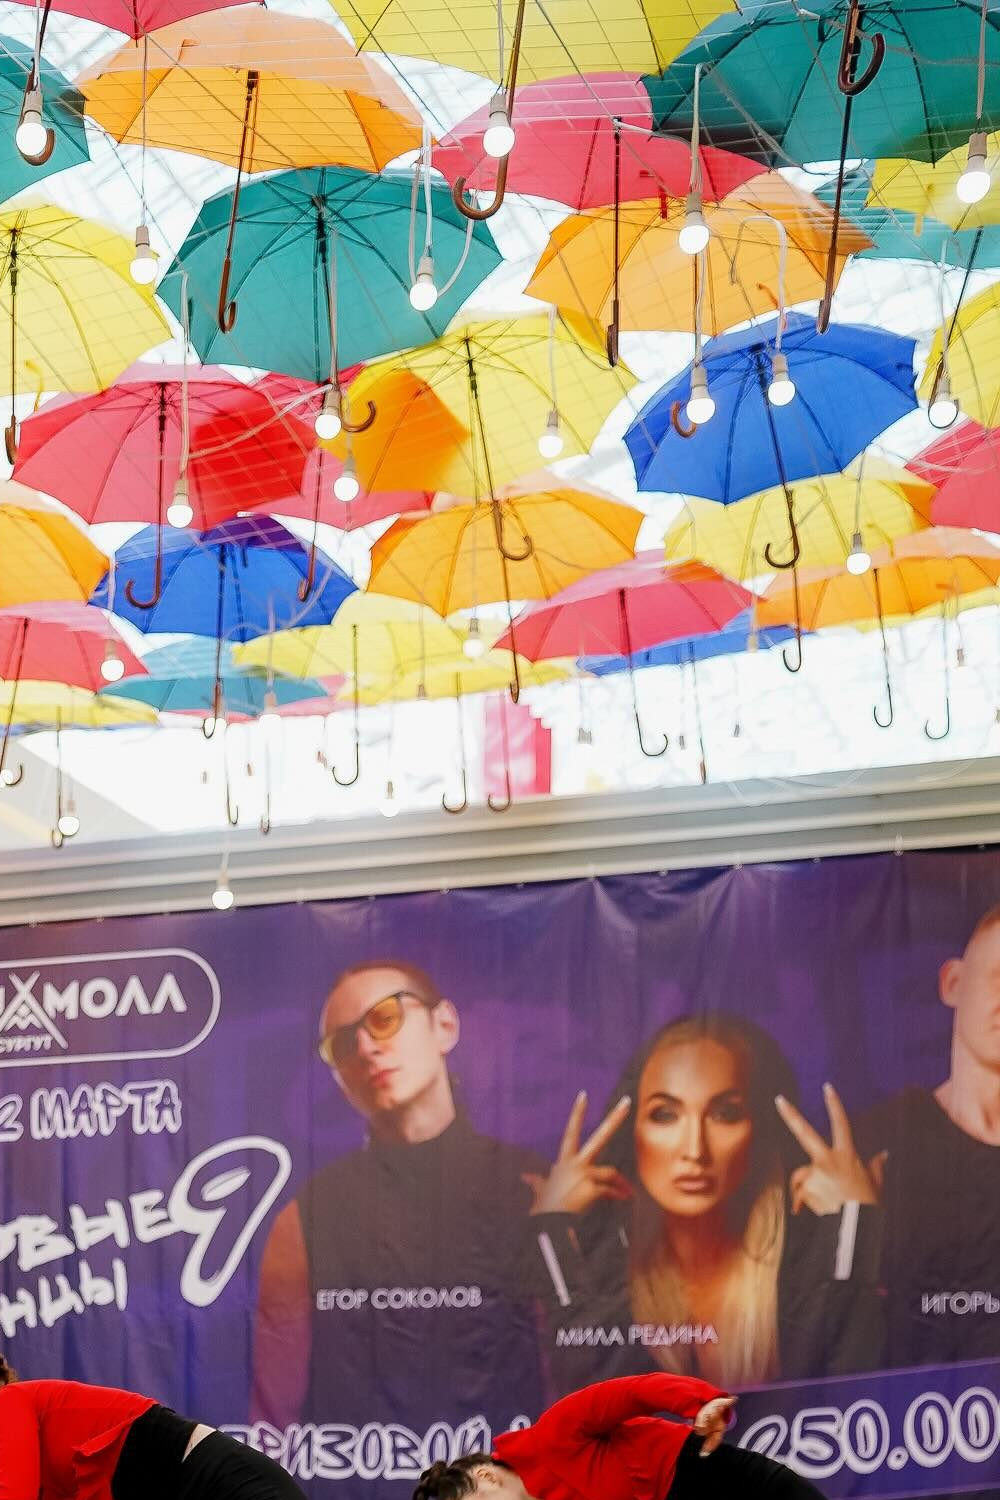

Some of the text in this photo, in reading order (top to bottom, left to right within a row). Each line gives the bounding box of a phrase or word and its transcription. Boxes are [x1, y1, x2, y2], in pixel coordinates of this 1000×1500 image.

[30, 1079, 182, 1140] МАРТА
[316, 1286, 482, 1310] ЕГОР СОКОЛОВ
[922, 1291, 1000, 1314] ИГОРЬ
[556, 1323, 719, 1347] МИЛА РЕДИНА
